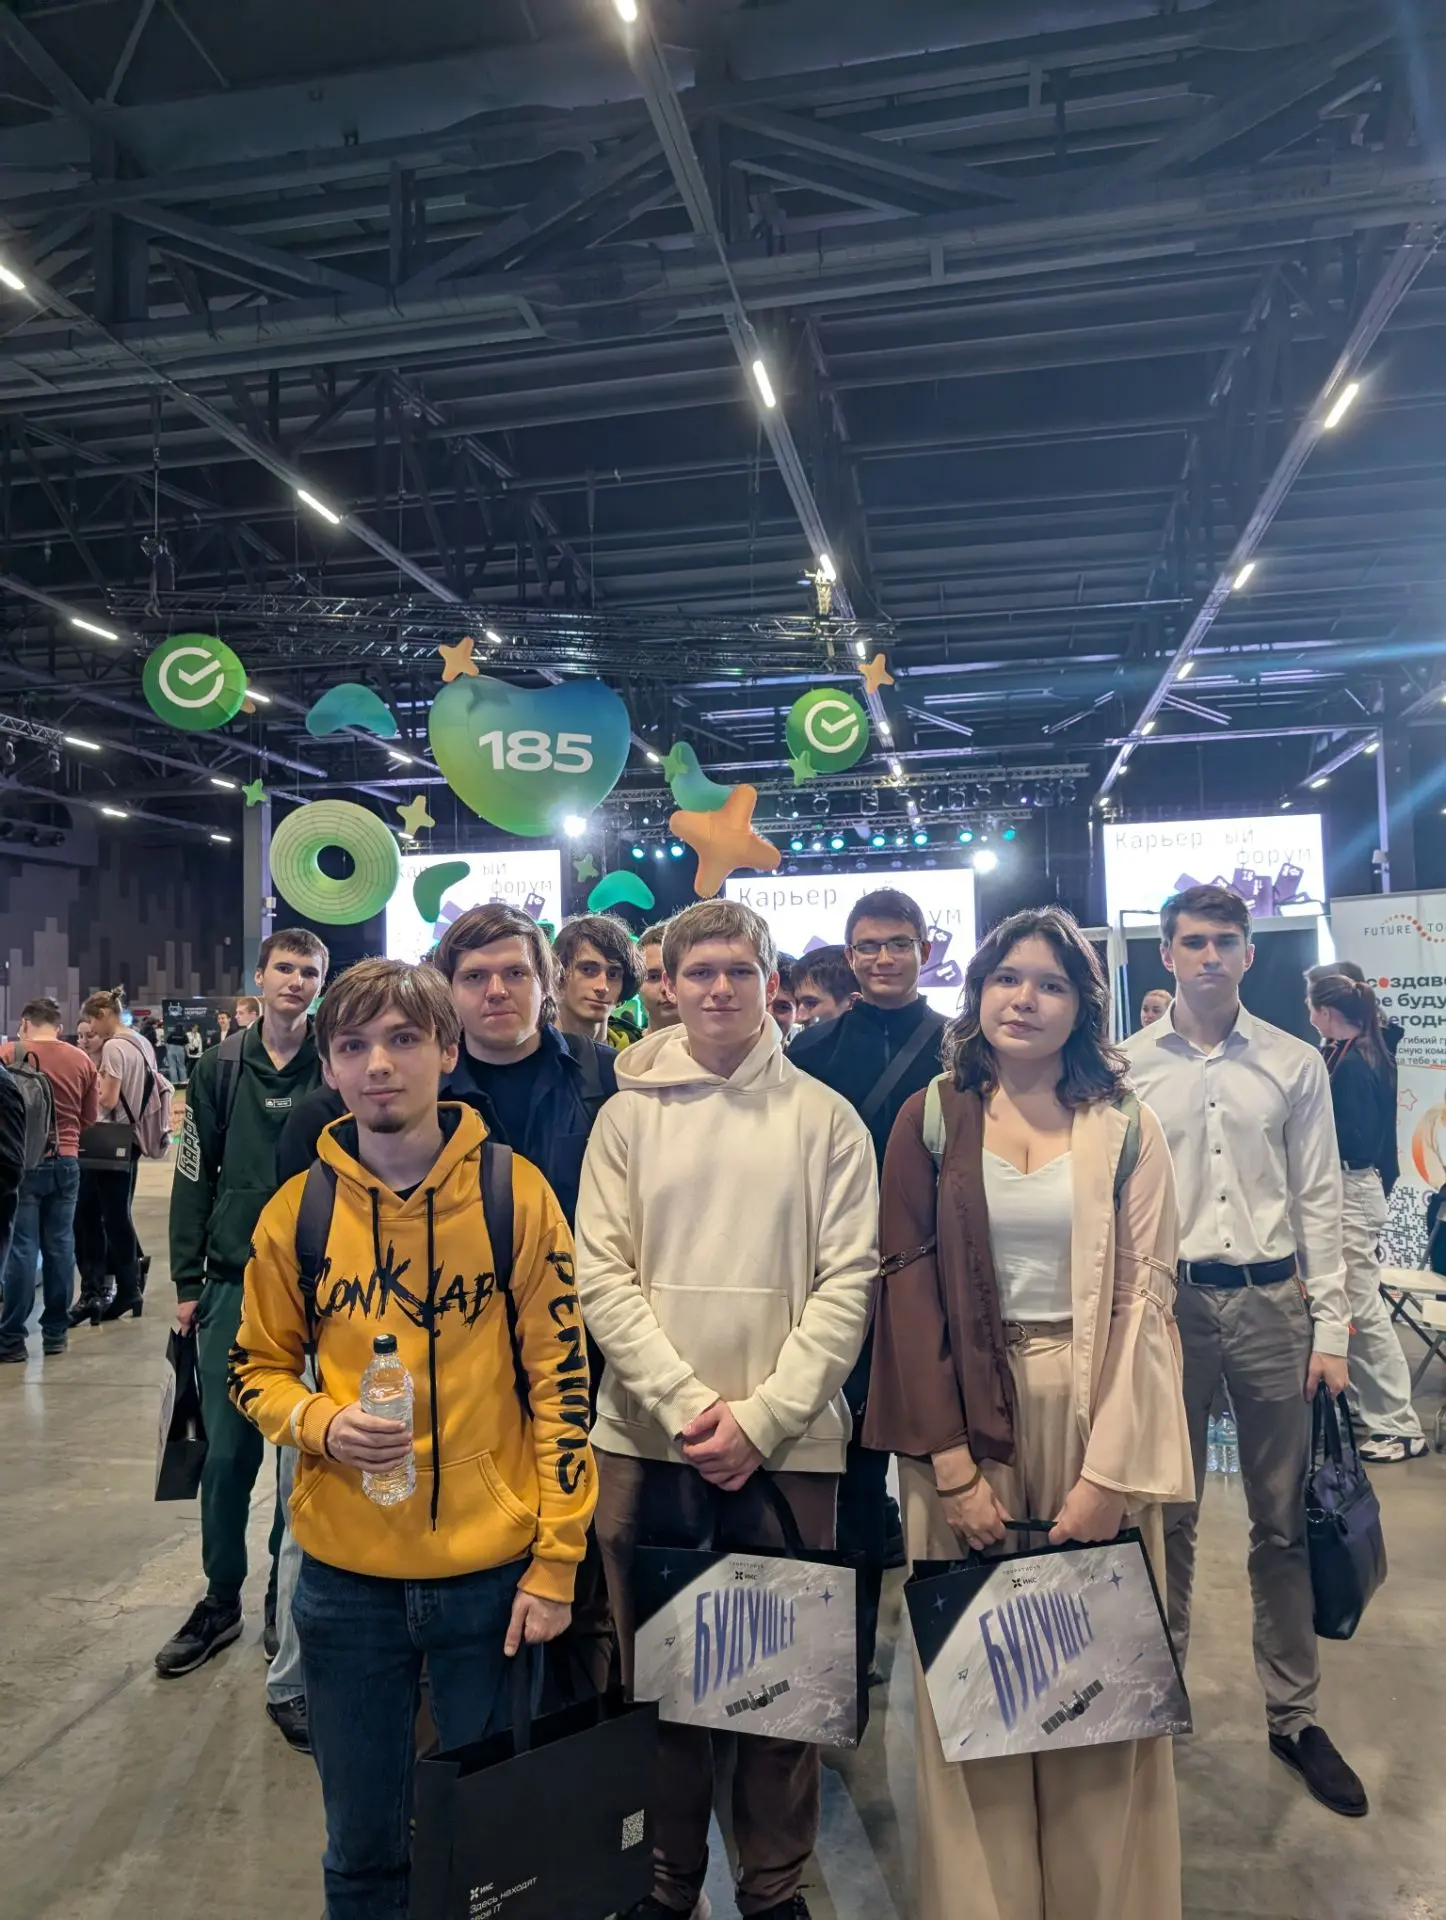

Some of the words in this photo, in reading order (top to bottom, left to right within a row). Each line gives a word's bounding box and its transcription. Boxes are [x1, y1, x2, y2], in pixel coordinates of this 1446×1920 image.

[479, 730, 593, 773] 185
[1364, 924, 1412, 936] FUTURE
[1427, 922, 1446, 933] TO
[1366, 975, 1446, 990] создав
[1388, 1015, 1446, 1028] егодн
[1403, 1036, 1437, 1044] гибкий
[1398, 1048, 1423, 1056] сную
[1022, 1576, 1037, 1585] ИКС
[693, 1586, 797, 1706] БУДУЩЕЕ
[978, 1589, 1095, 1733] БУДУЩЕЕ
[470, 1896, 498, 1914] Здесь
[500, 1876, 538, 1899] находят
[480, 1882, 494, 1894] ИКС
